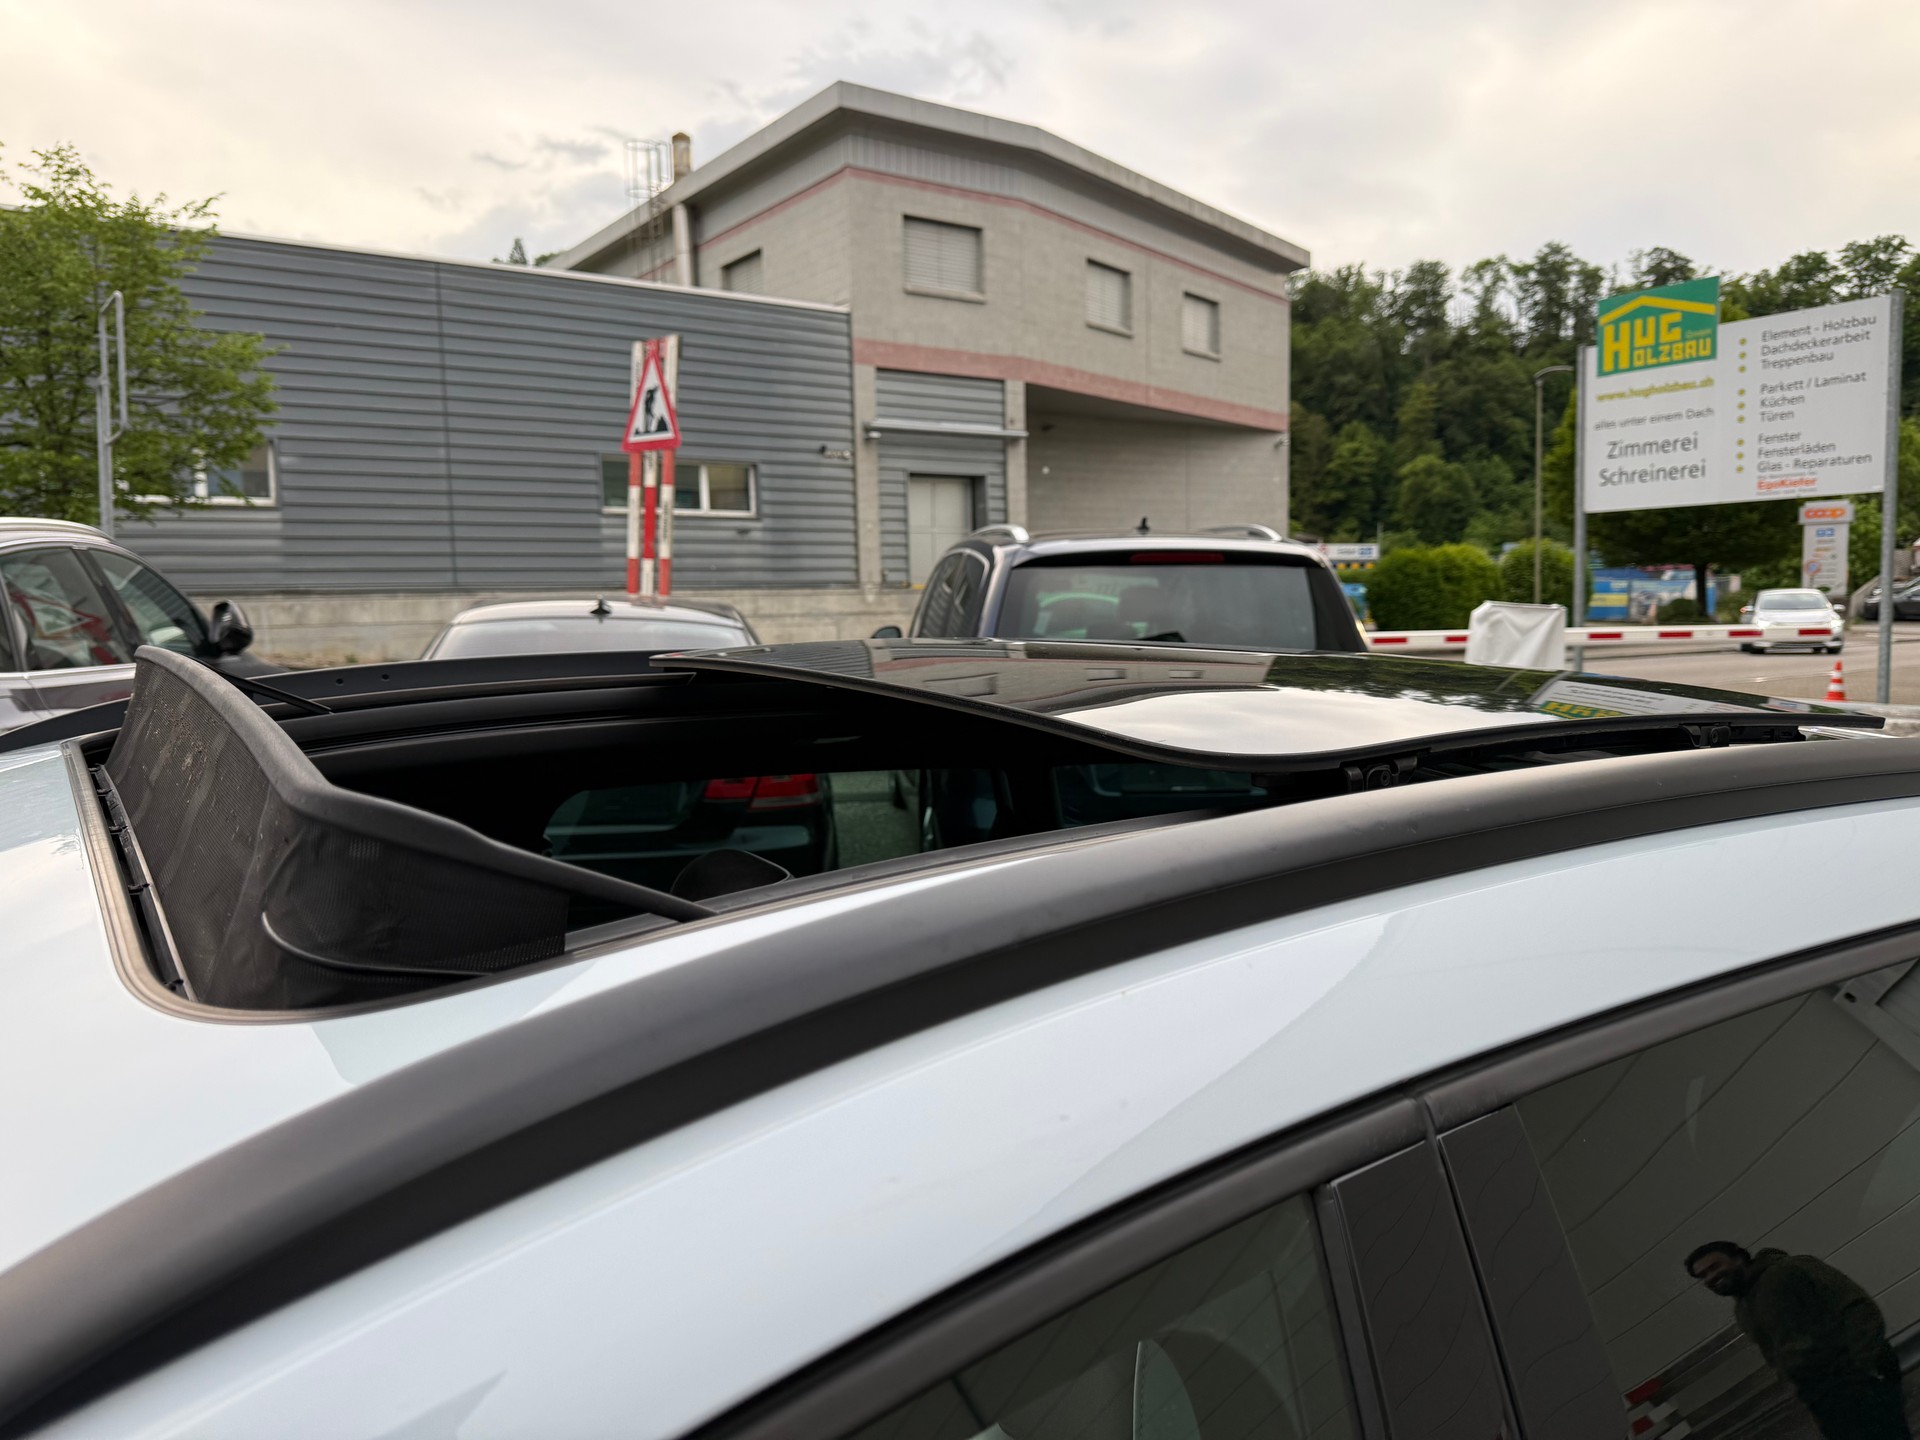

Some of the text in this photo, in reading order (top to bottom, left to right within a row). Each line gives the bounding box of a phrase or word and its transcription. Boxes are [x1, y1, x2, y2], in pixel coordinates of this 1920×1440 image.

[1762, 325, 1811, 342] Element
[1823, 316, 1877, 332] Holzbau
[1603, 311, 1682, 372] HUG
[1761, 331, 1870, 356] Dachdeckerarbeit
[1761, 352, 1834, 369] Treppenbau
[1761, 380, 1803, 394] Parkett
[1814, 372, 1866, 388] Laminat
[1760, 395, 1805, 408] Küchen
[1619, 416, 1647, 428] unter
[1649, 411, 1683, 423] einem
[1685, 407, 1714, 419] Dach
[1760, 410, 1795, 422] Türen
[1607, 431, 1698, 459] Zimmerei
[1758, 431, 1801, 444] Fenster
[1758, 442, 1836, 458] Fensterläden
[1599, 458, 1706, 487] Schreinerei
[1757, 461, 1782, 473] Glas
[1793, 454, 1872, 469] Reparaturen
